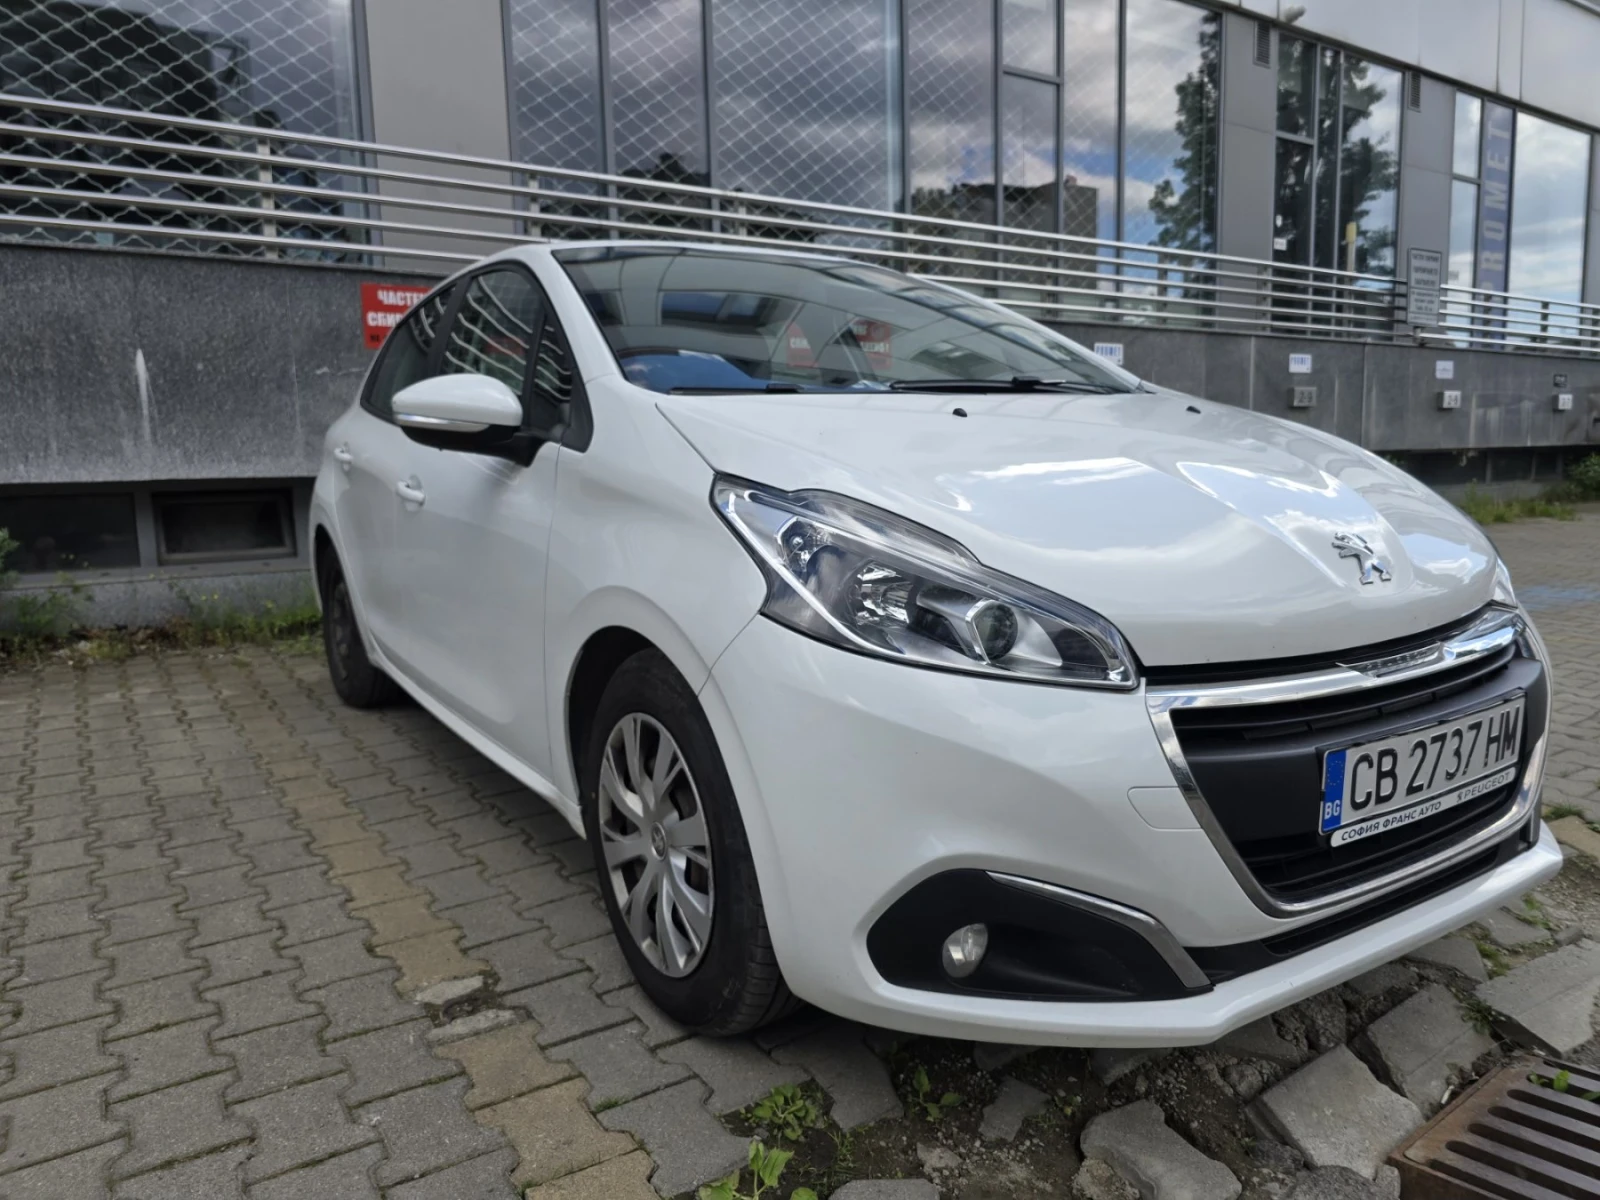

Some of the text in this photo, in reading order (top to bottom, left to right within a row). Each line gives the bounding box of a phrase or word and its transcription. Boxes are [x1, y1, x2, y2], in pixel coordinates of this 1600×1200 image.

[1406, 719, 1483, 797] 2737
[1463, 771, 1510, 799] PEUGEOT
[1323, 799, 1341, 820] BG
[1341, 801, 1442, 841] СОФИЯ ФРАНС АУТО
